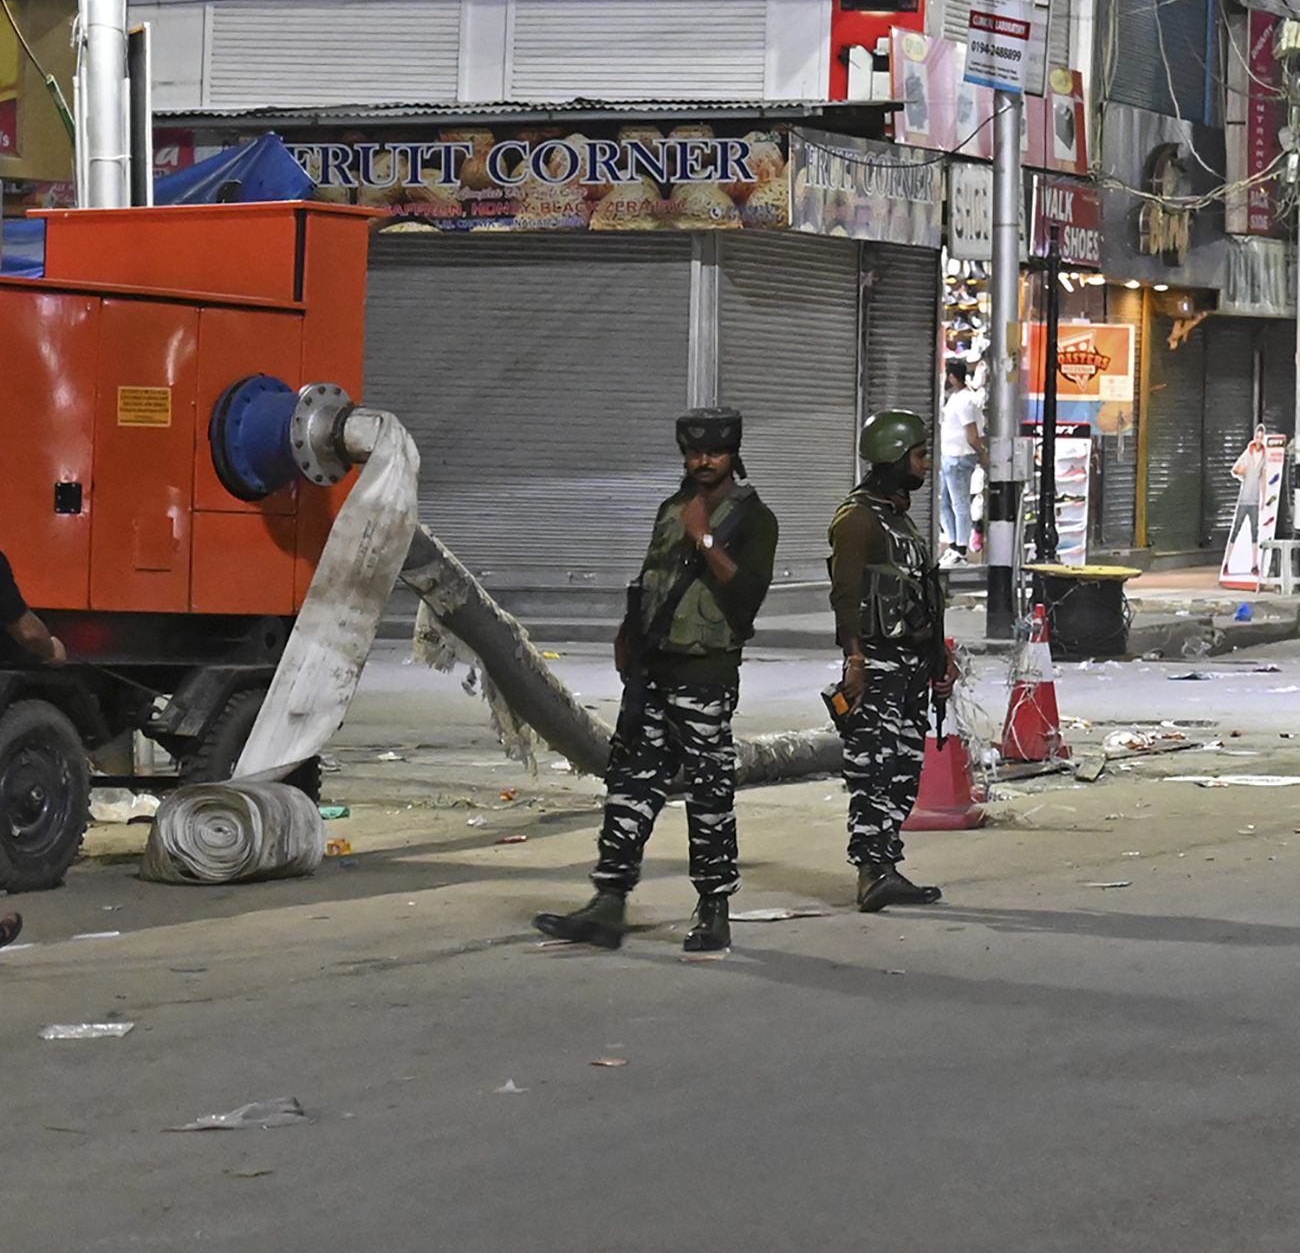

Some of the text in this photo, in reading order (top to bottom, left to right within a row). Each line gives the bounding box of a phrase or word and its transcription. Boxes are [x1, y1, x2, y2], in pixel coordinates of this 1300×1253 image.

[289, 138, 759, 188] FRUIT CORNER
[1041, 185, 1074, 223] WALK
[1064, 225, 1101, 261] SHOES
[1057, 352, 1110, 370] OASTERS
